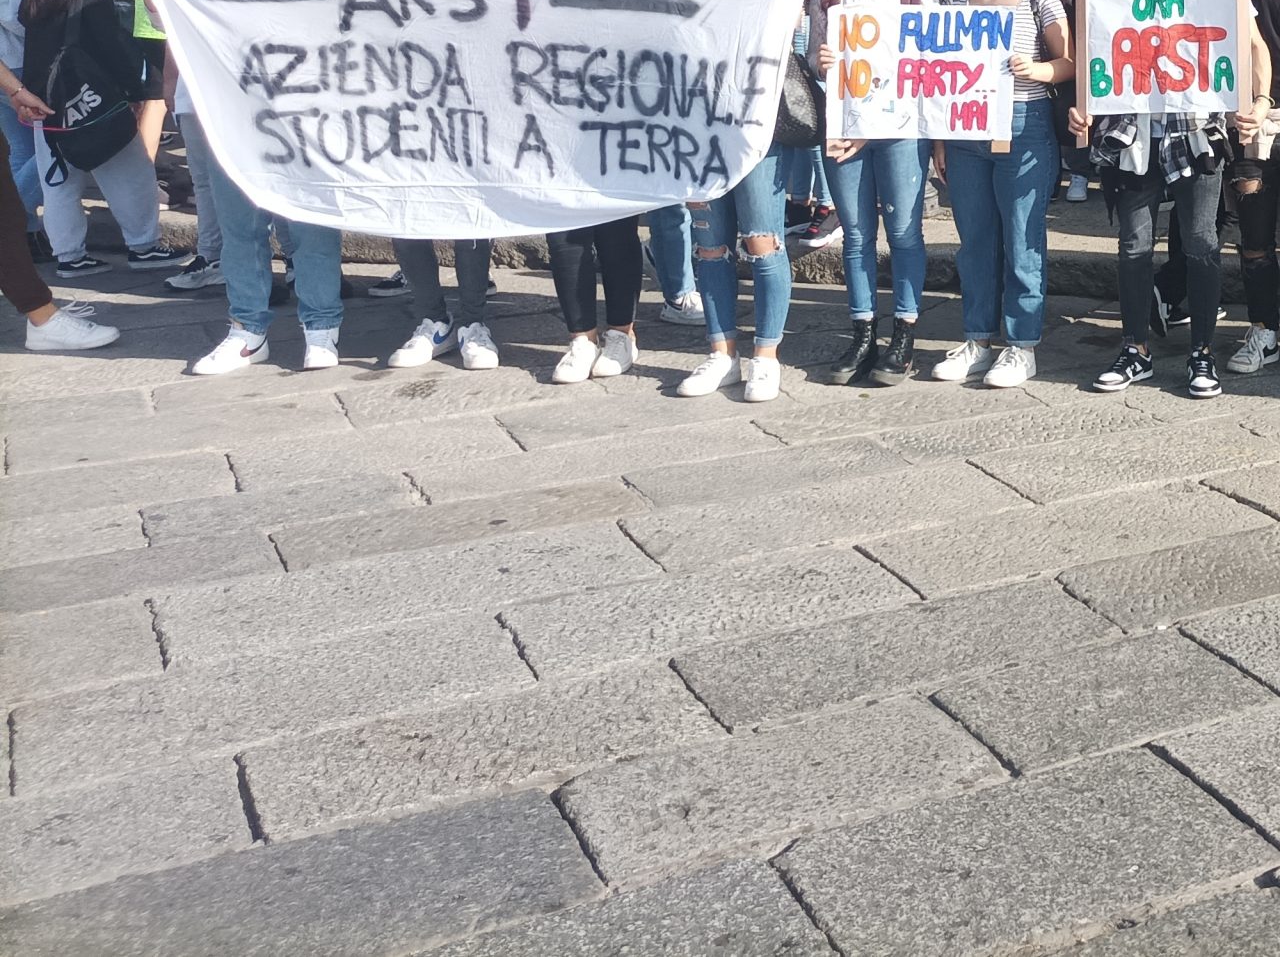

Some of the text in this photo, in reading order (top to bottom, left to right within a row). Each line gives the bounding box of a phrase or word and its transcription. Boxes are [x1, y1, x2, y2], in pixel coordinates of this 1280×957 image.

[839, 10, 1013, 53] NO PULLMAN
[240, 41, 780, 127] AZIENDA REGIONALE
[839, 59, 872, 100] NO
[255, 102, 729, 187] STUDENTI A TERRA
